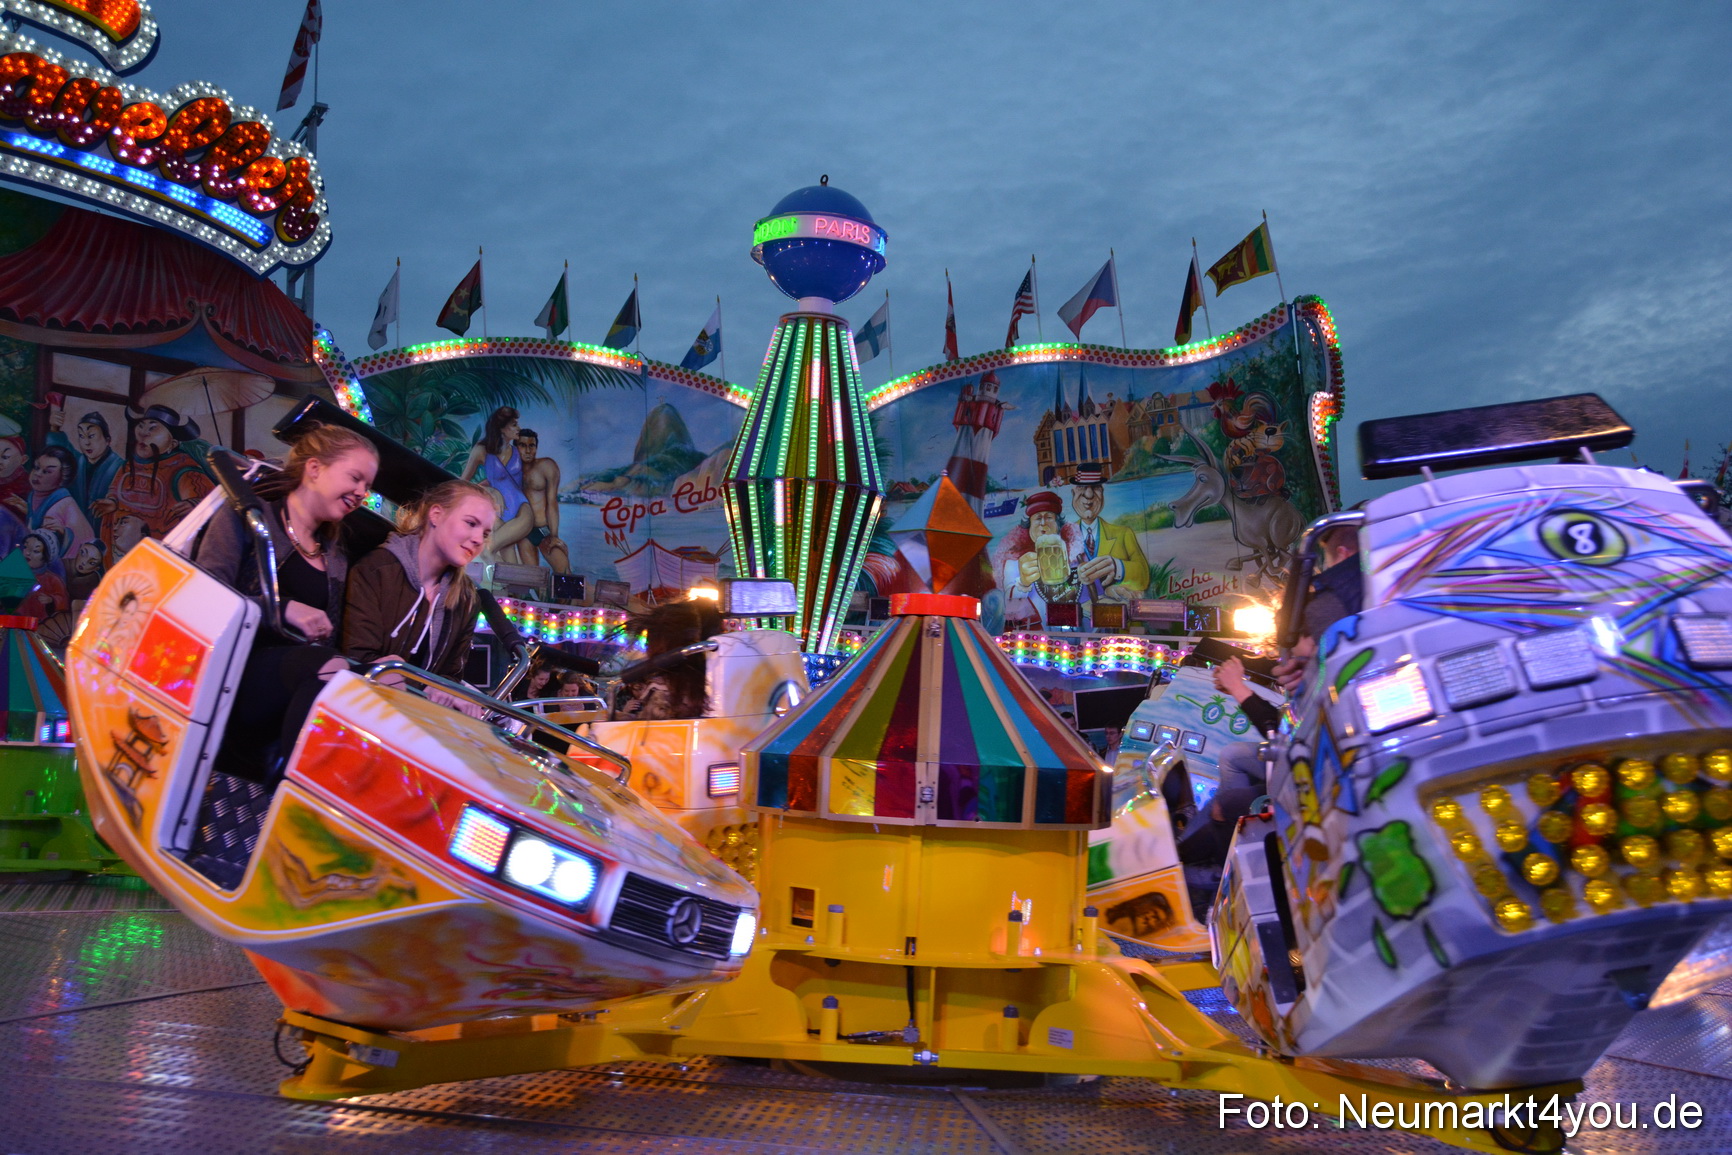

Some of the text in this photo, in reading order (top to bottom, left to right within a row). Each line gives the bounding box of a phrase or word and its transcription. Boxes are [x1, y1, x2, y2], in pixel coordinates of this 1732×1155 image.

[815, 217, 871, 244] PARIS
[600, 496, 667, 533] Copa
[1567, 522, 1597, 555] 8
